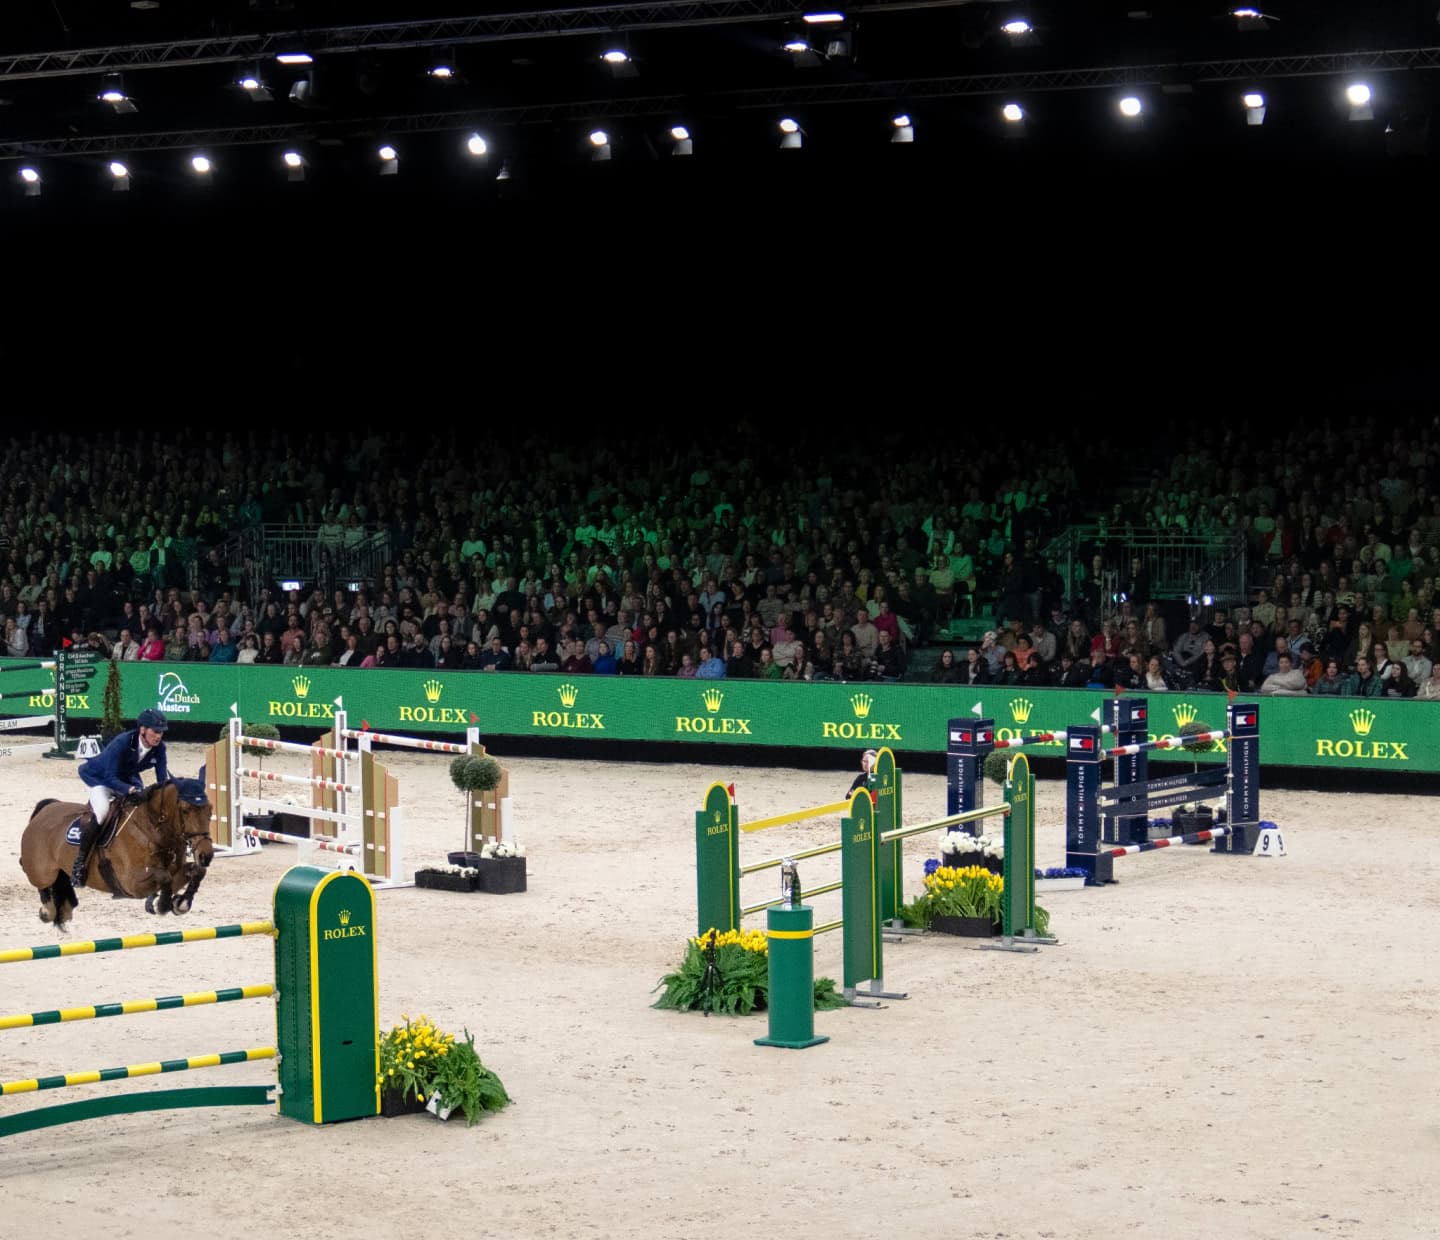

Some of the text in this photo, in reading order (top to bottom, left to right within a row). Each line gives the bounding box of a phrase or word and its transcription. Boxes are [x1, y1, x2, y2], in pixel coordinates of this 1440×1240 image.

[29, 694, 90, 709] ROEX
[157, 701, 191, 712] Masters
[175, 694, 200, 704] Dutch
[268, 701, 334, 719] ROLEX
[399, 706, 468, 724] ROLEX
[532, 711, 606, 729] ROLEX
[675, 716, 753, 735] ROLEX
[822, 721, 903, 740] ROLEX
[1316, 739, 1408, 760] ROLEX
[244, 834, 256, 849] 16
[1262, 834, 1270, 851] 9
[324, 925, 366, 940] ROLEX
